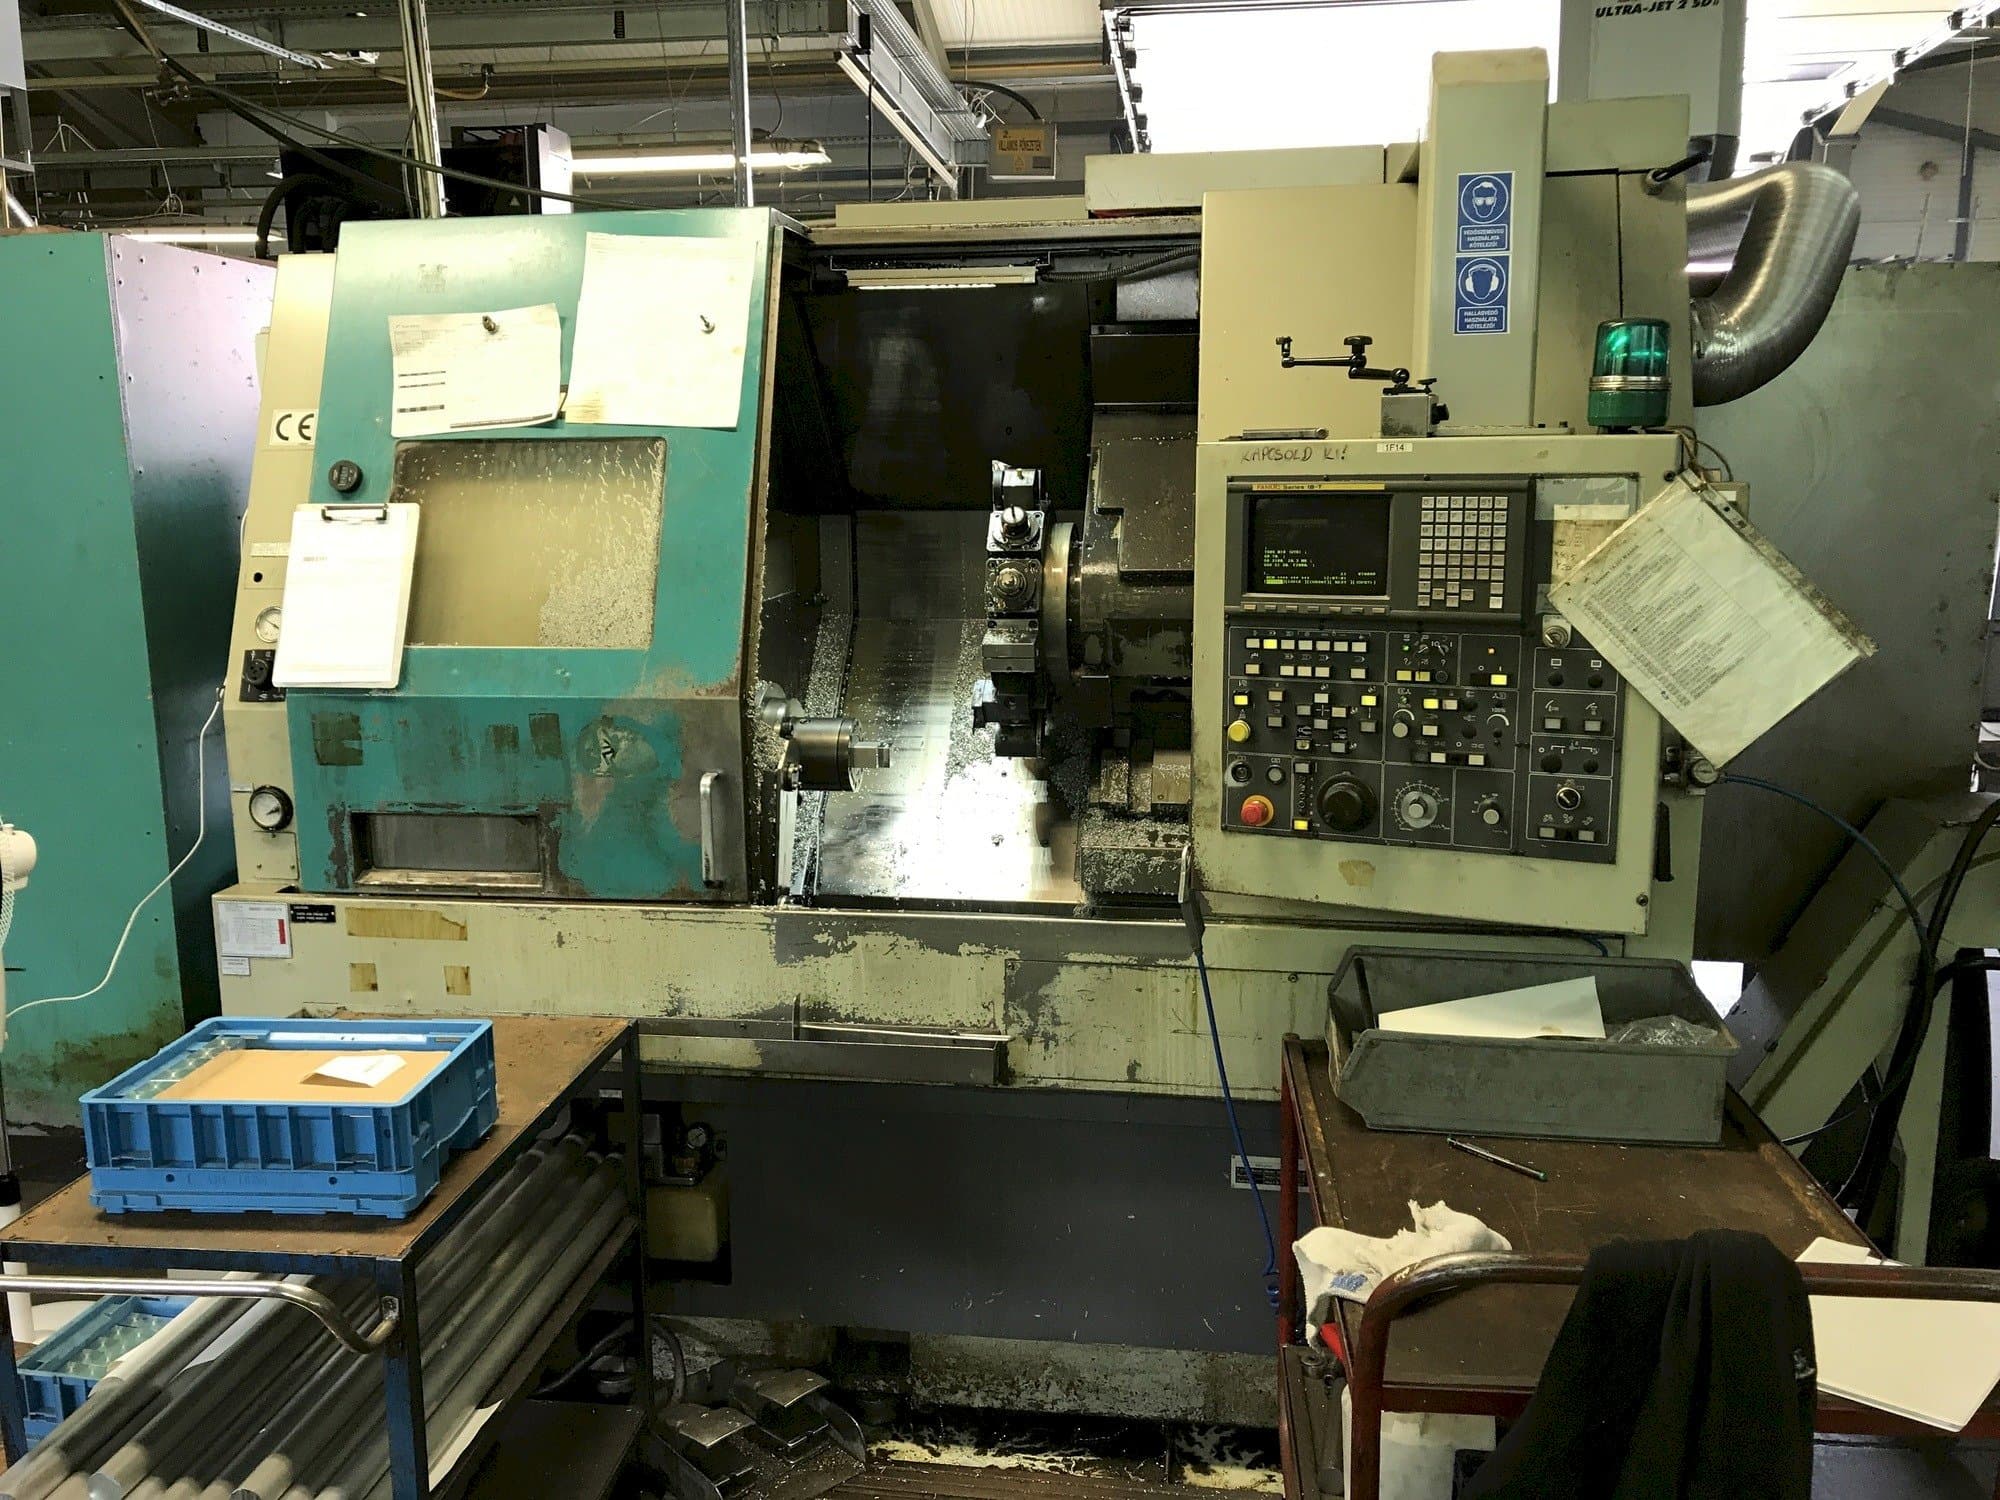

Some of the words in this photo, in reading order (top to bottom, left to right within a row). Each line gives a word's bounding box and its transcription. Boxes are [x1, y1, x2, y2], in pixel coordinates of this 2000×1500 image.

[1595, 0, 1675, 18] ULTRA-JET
[1677, 0, 1688, 9] 2
[275, 413, 315, 441] CE
[1385, 443, 1405, 451] 1F14
